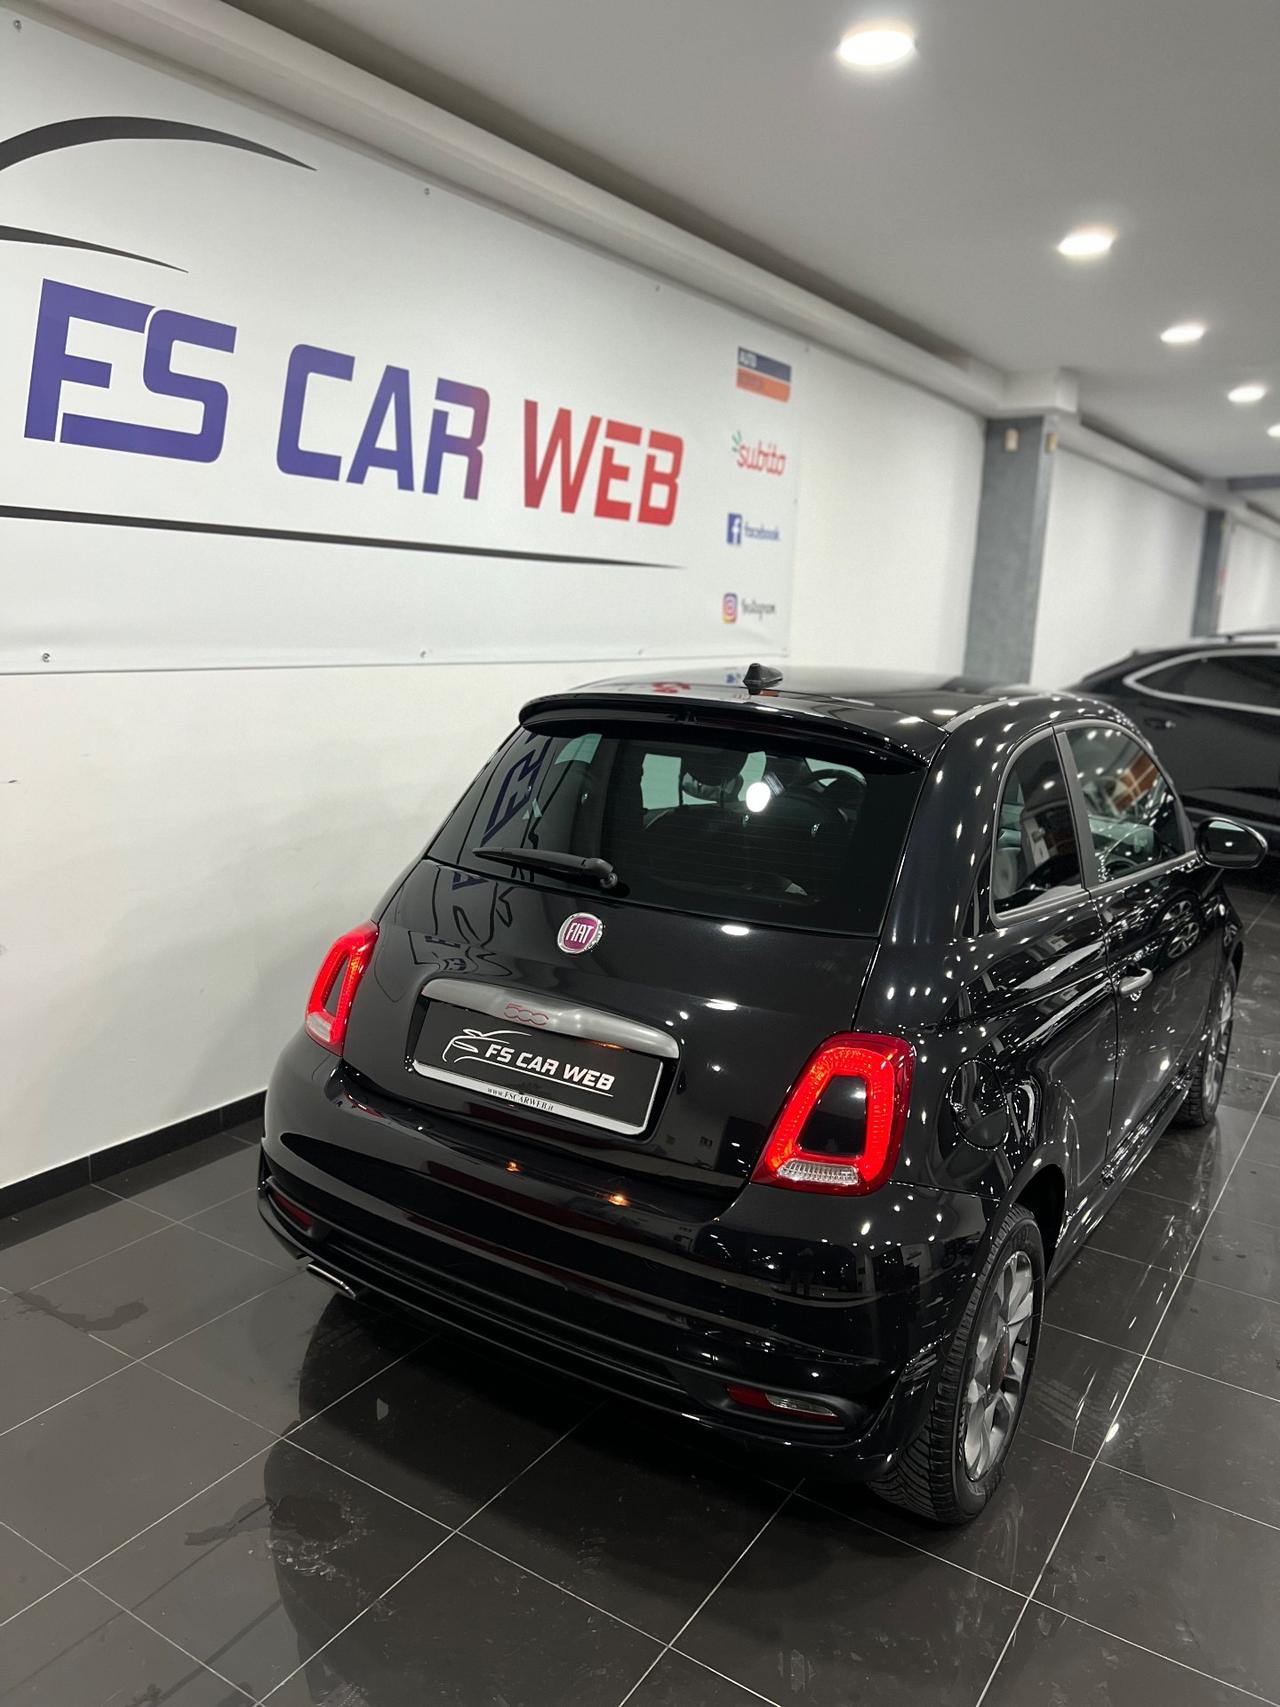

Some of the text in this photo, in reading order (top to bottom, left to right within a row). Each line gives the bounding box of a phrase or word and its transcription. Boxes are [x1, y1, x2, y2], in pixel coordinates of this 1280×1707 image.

[24, 278, 684, 526] FS CAR WEB
[737, 441, 786, 476] subito
[565, 922, 594, 944] FIAT
[504, 1003, 549, 1026] 500
[485, 1044, 615, 1091] FS CAR WEB
